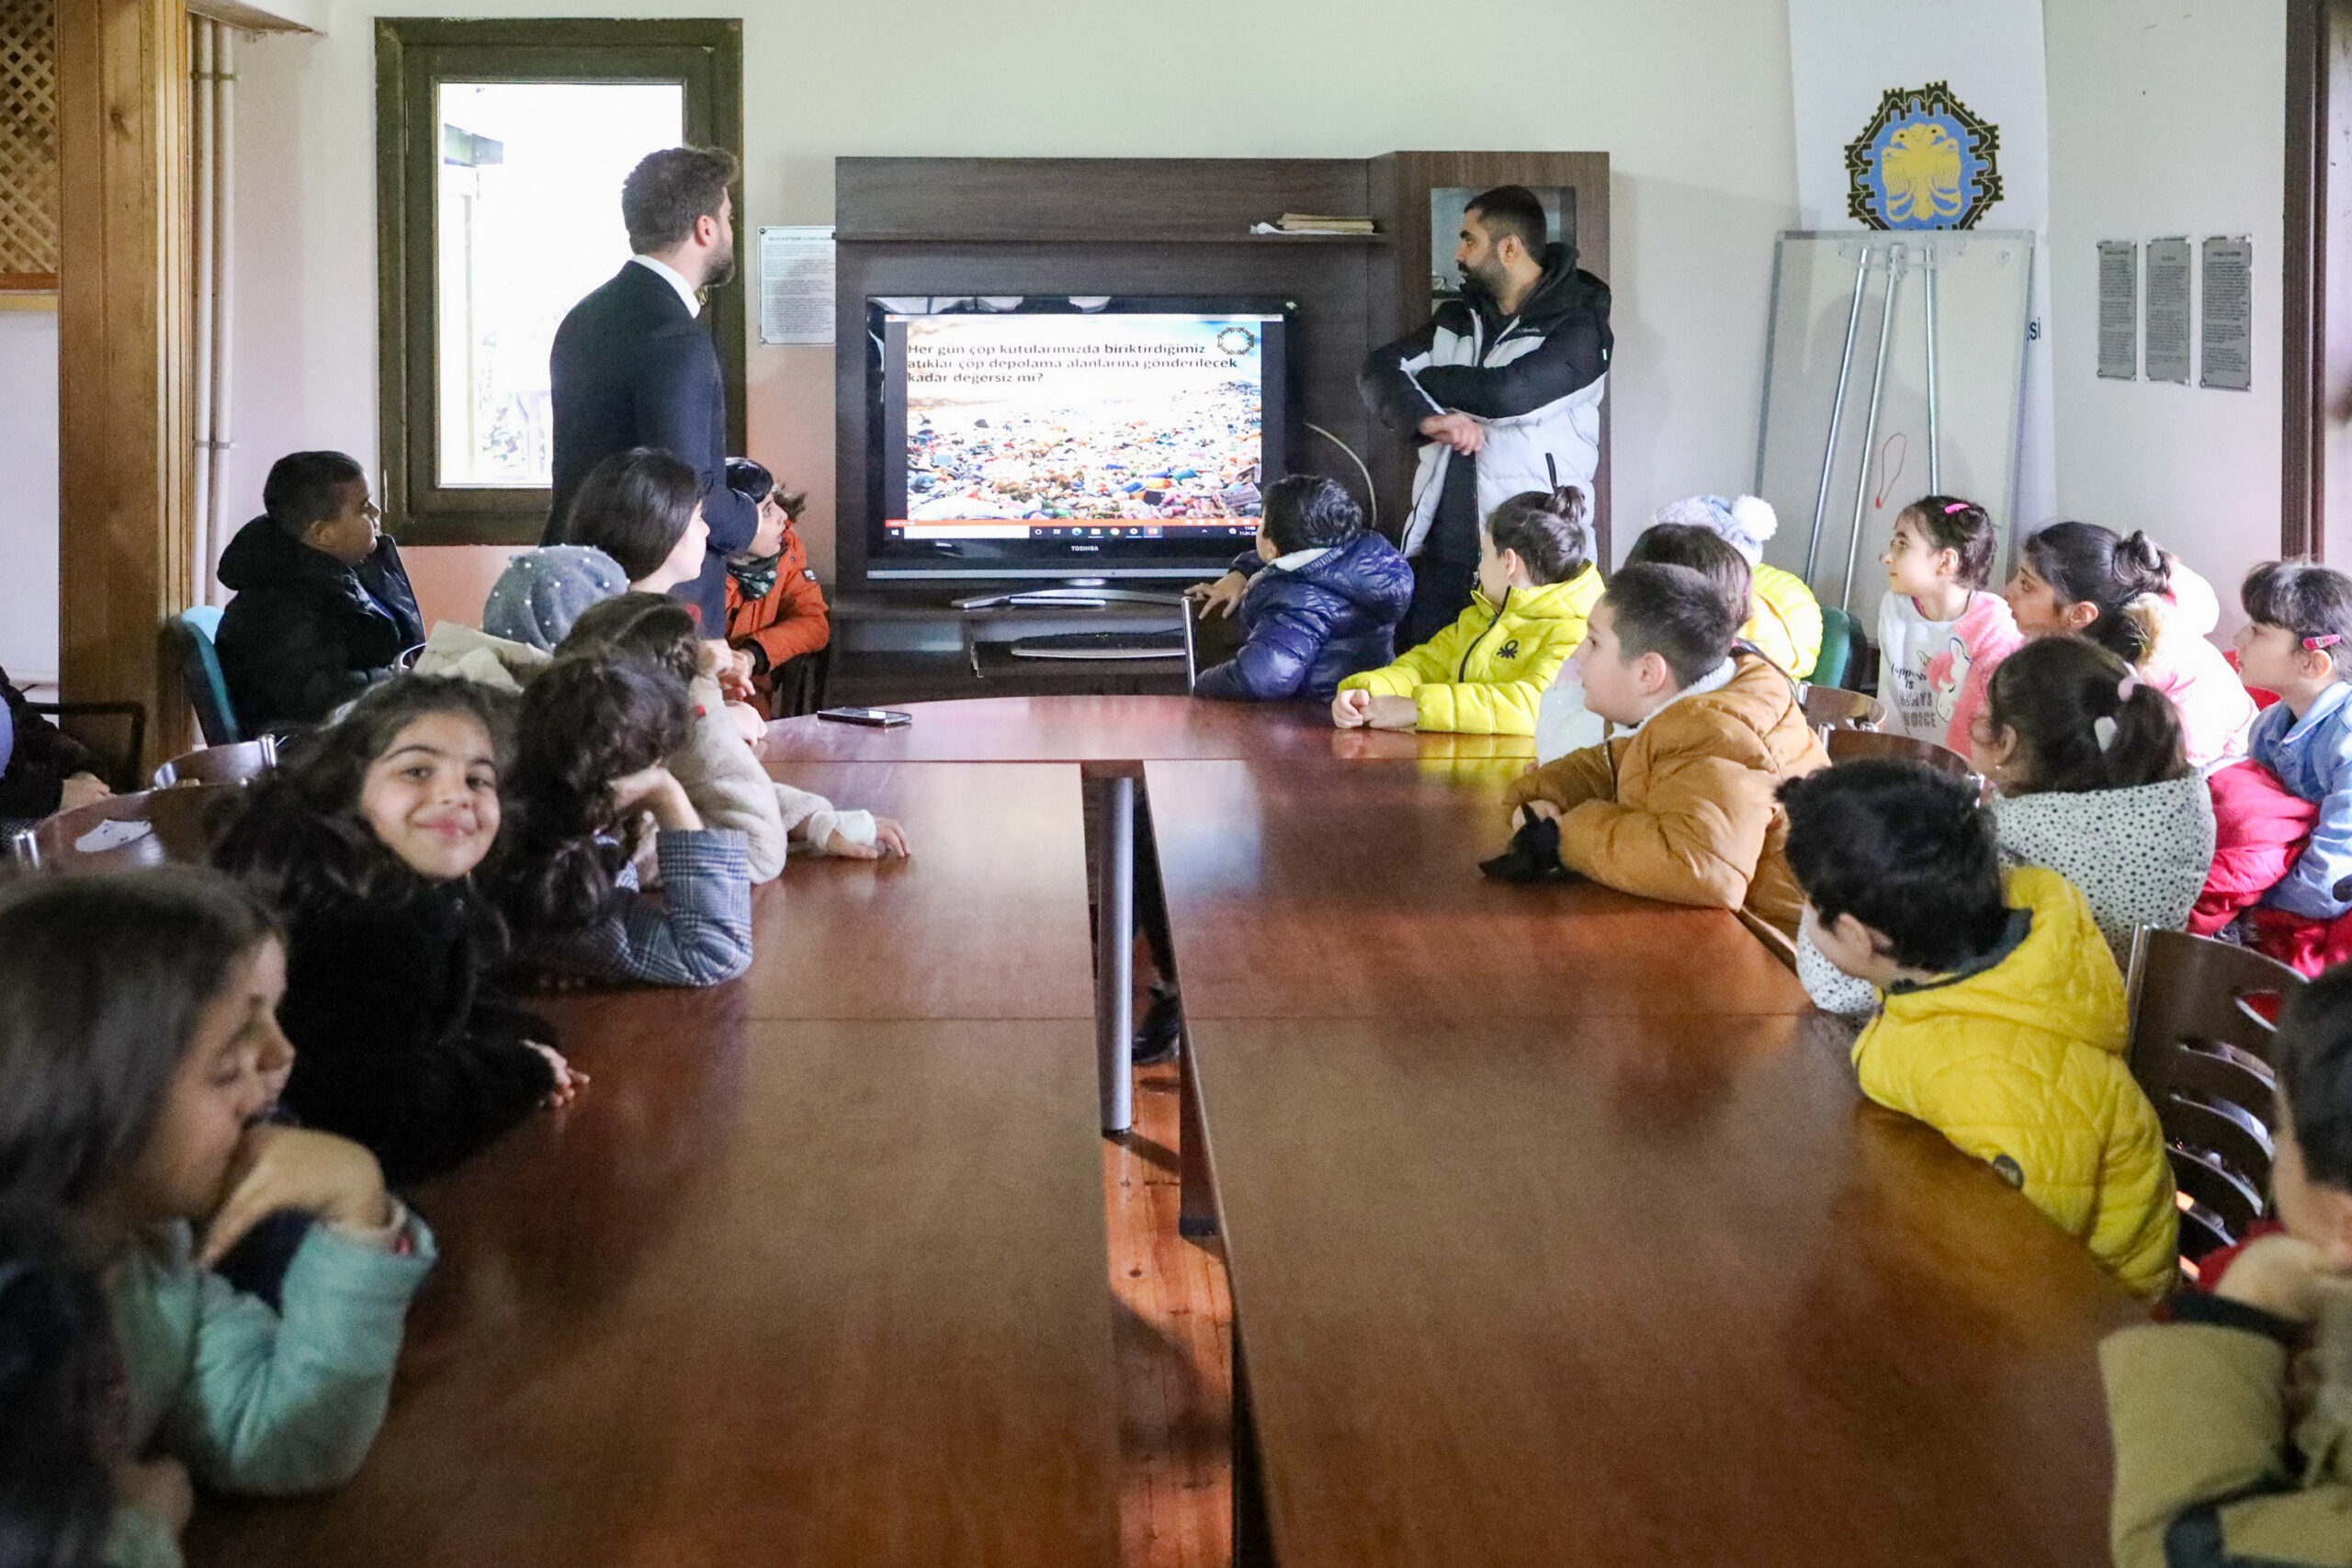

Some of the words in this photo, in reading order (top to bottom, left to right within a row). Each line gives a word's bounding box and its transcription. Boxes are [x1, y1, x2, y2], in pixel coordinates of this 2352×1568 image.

[908, 344, 933, 355] Her
[937, 344, 965, 356] gün
[969, 344, 995, 356] çöp
[1000, 344, 1101, 355] kutularımızda
[1104, 344, 1206, 356] biriktirdiğimiz
[907, 357, 953, 368] atıklar
[958, 358, 985, 370] çöp
[989, 358, 1062, 370] depolama
[1067, 358, 1139, 368] alanlarına
[1143, 357, 1238, 370] gönderilecek
[907, 372, 948, 383] kadar
[953, 372, 1012, 385] değersiz
